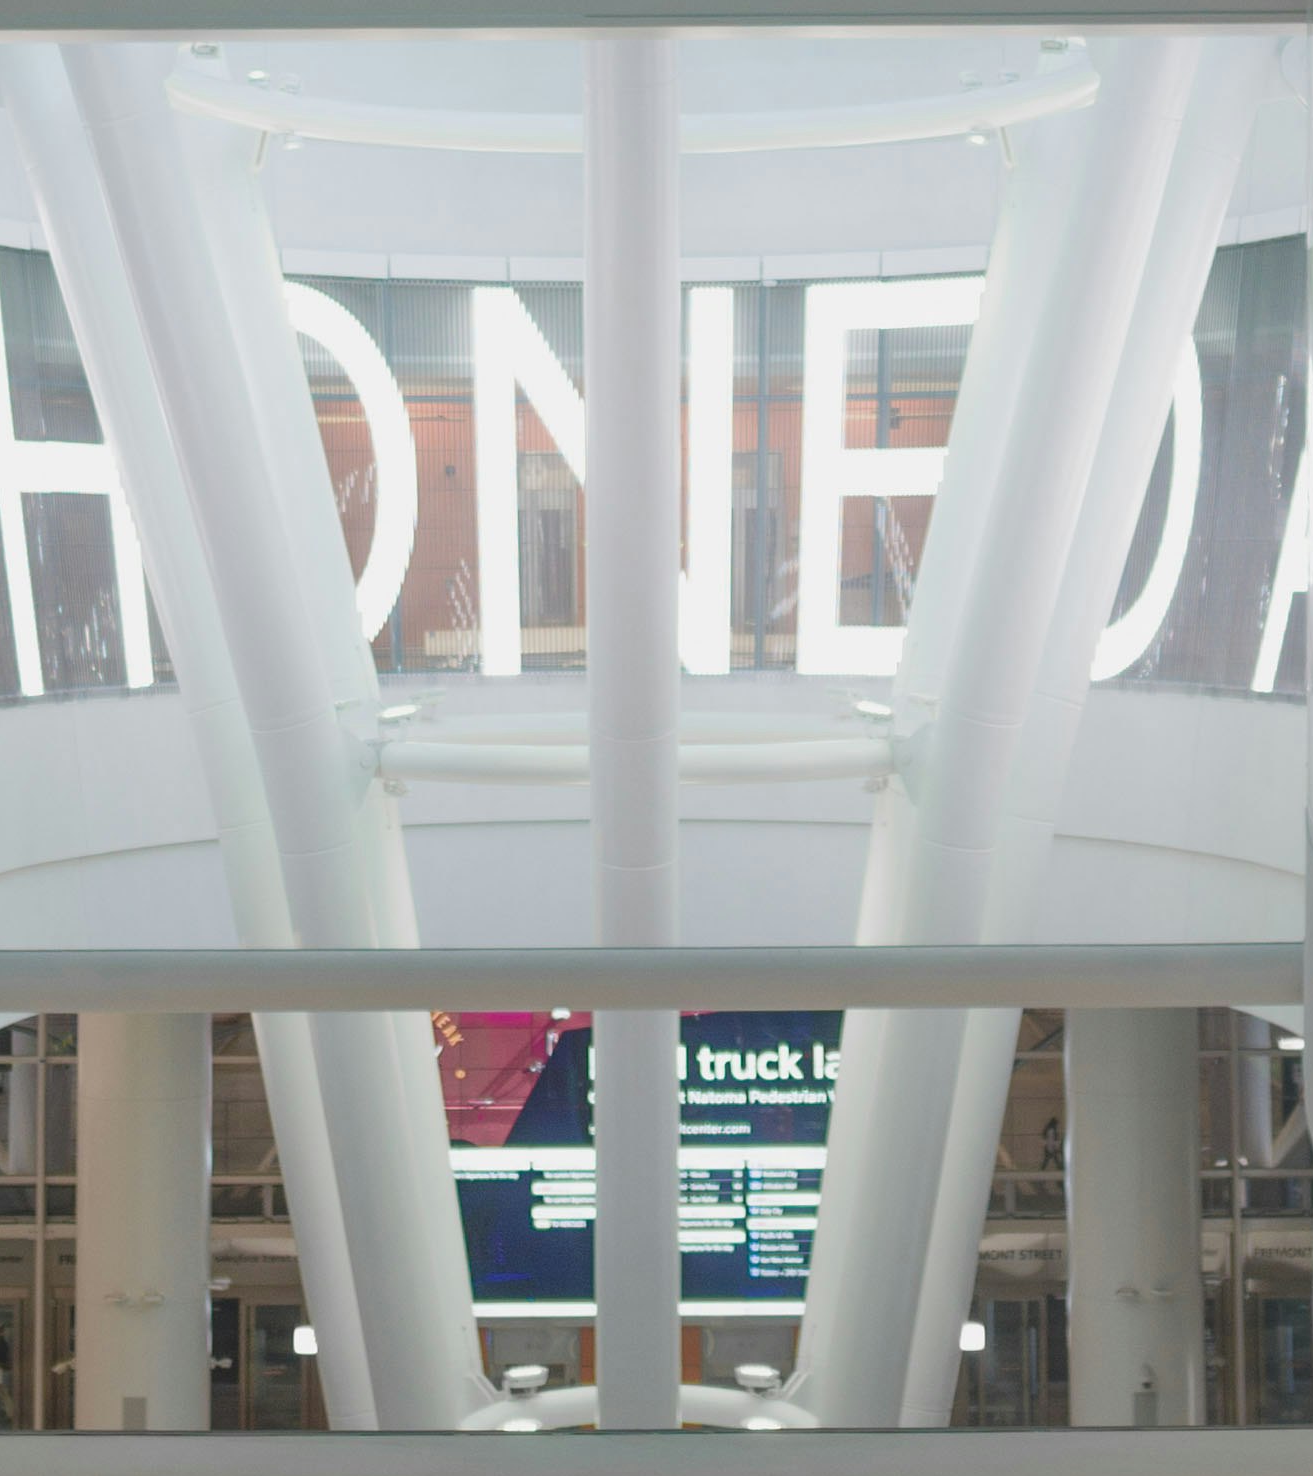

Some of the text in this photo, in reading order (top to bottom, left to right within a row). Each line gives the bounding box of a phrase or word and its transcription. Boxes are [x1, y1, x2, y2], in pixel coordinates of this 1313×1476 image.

[696, 1044, 804, 1080] truck
[748, 1089, 827, 1104] Pedestrian
[1020, 1249, 1062, 1260] STREET
